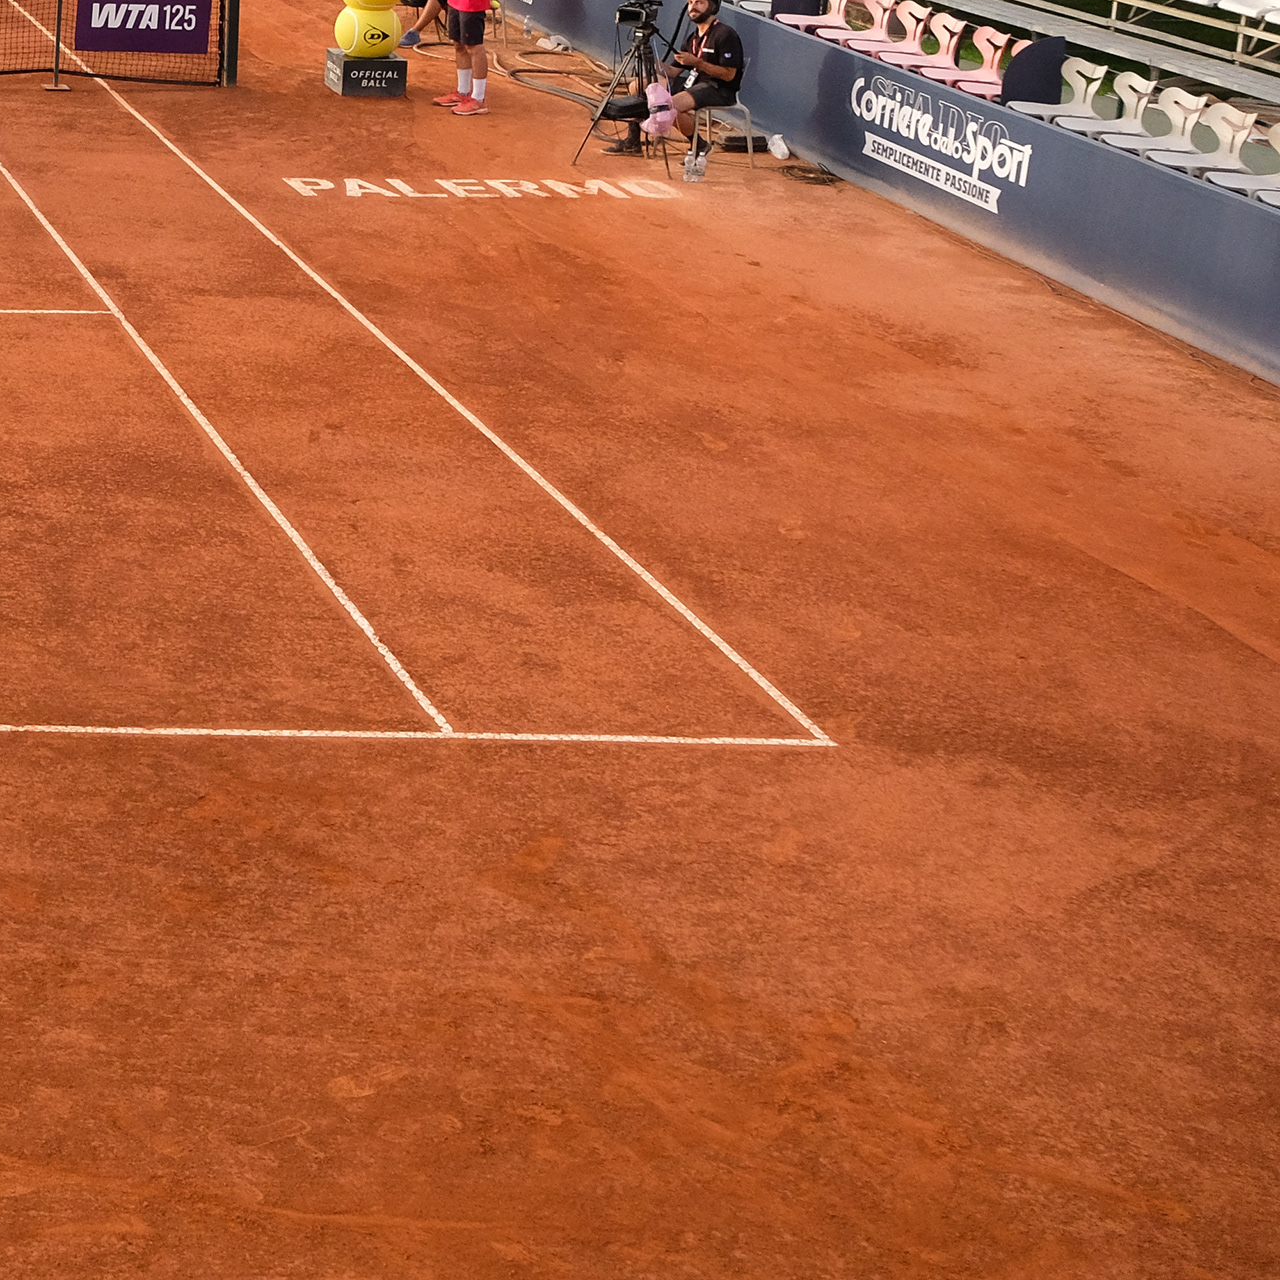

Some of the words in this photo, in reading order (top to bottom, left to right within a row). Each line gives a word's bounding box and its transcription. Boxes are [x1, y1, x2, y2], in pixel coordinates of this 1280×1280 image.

[91, 3, 159, 30] WTA
[163, 4, 197, 31] 125
[350, 70, 399, 78] OFFICIAL
[361, 79, 388, 87] BALL
[851, 77, 934, 146] Corriere
[962, 122, 1033, 188] Sport
[870, 140, 941, 182] SEMPLICEMENTE
[944, 173, 991, 204] PASSIONE
[282, 177, 683, 199] PALERMO
